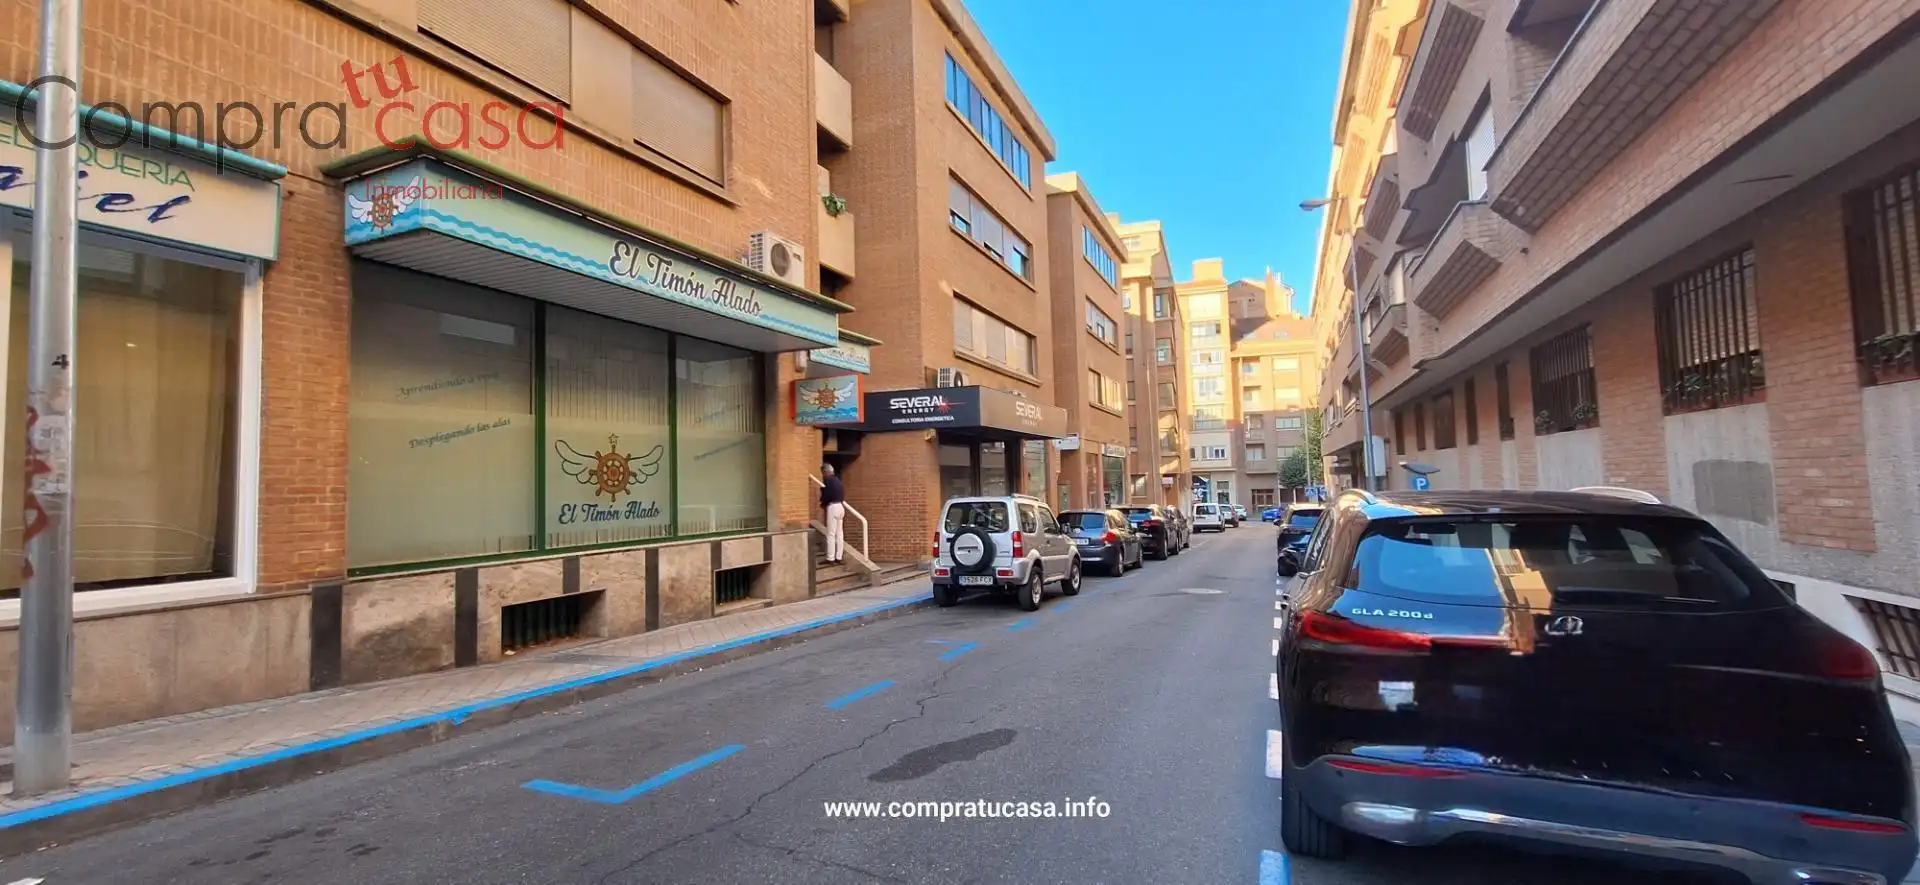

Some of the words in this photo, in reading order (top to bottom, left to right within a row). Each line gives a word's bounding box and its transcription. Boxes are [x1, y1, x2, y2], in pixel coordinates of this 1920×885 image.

[608, 240, 640, 279] El
[647, 252, 706, 300] Timón
[712, 276, 762, 318] Alado
[890, 395, 946, 409] SEVERAL
[1415, 477, 1427, 491] P
[558, 503, 577, 525] El
[581, 503, 621, 523] Timón
[624, 500, 660, 520] Alado
[1351, 607, 1384, 616] GLA
[1388, 609, 1434, 619] 200d
